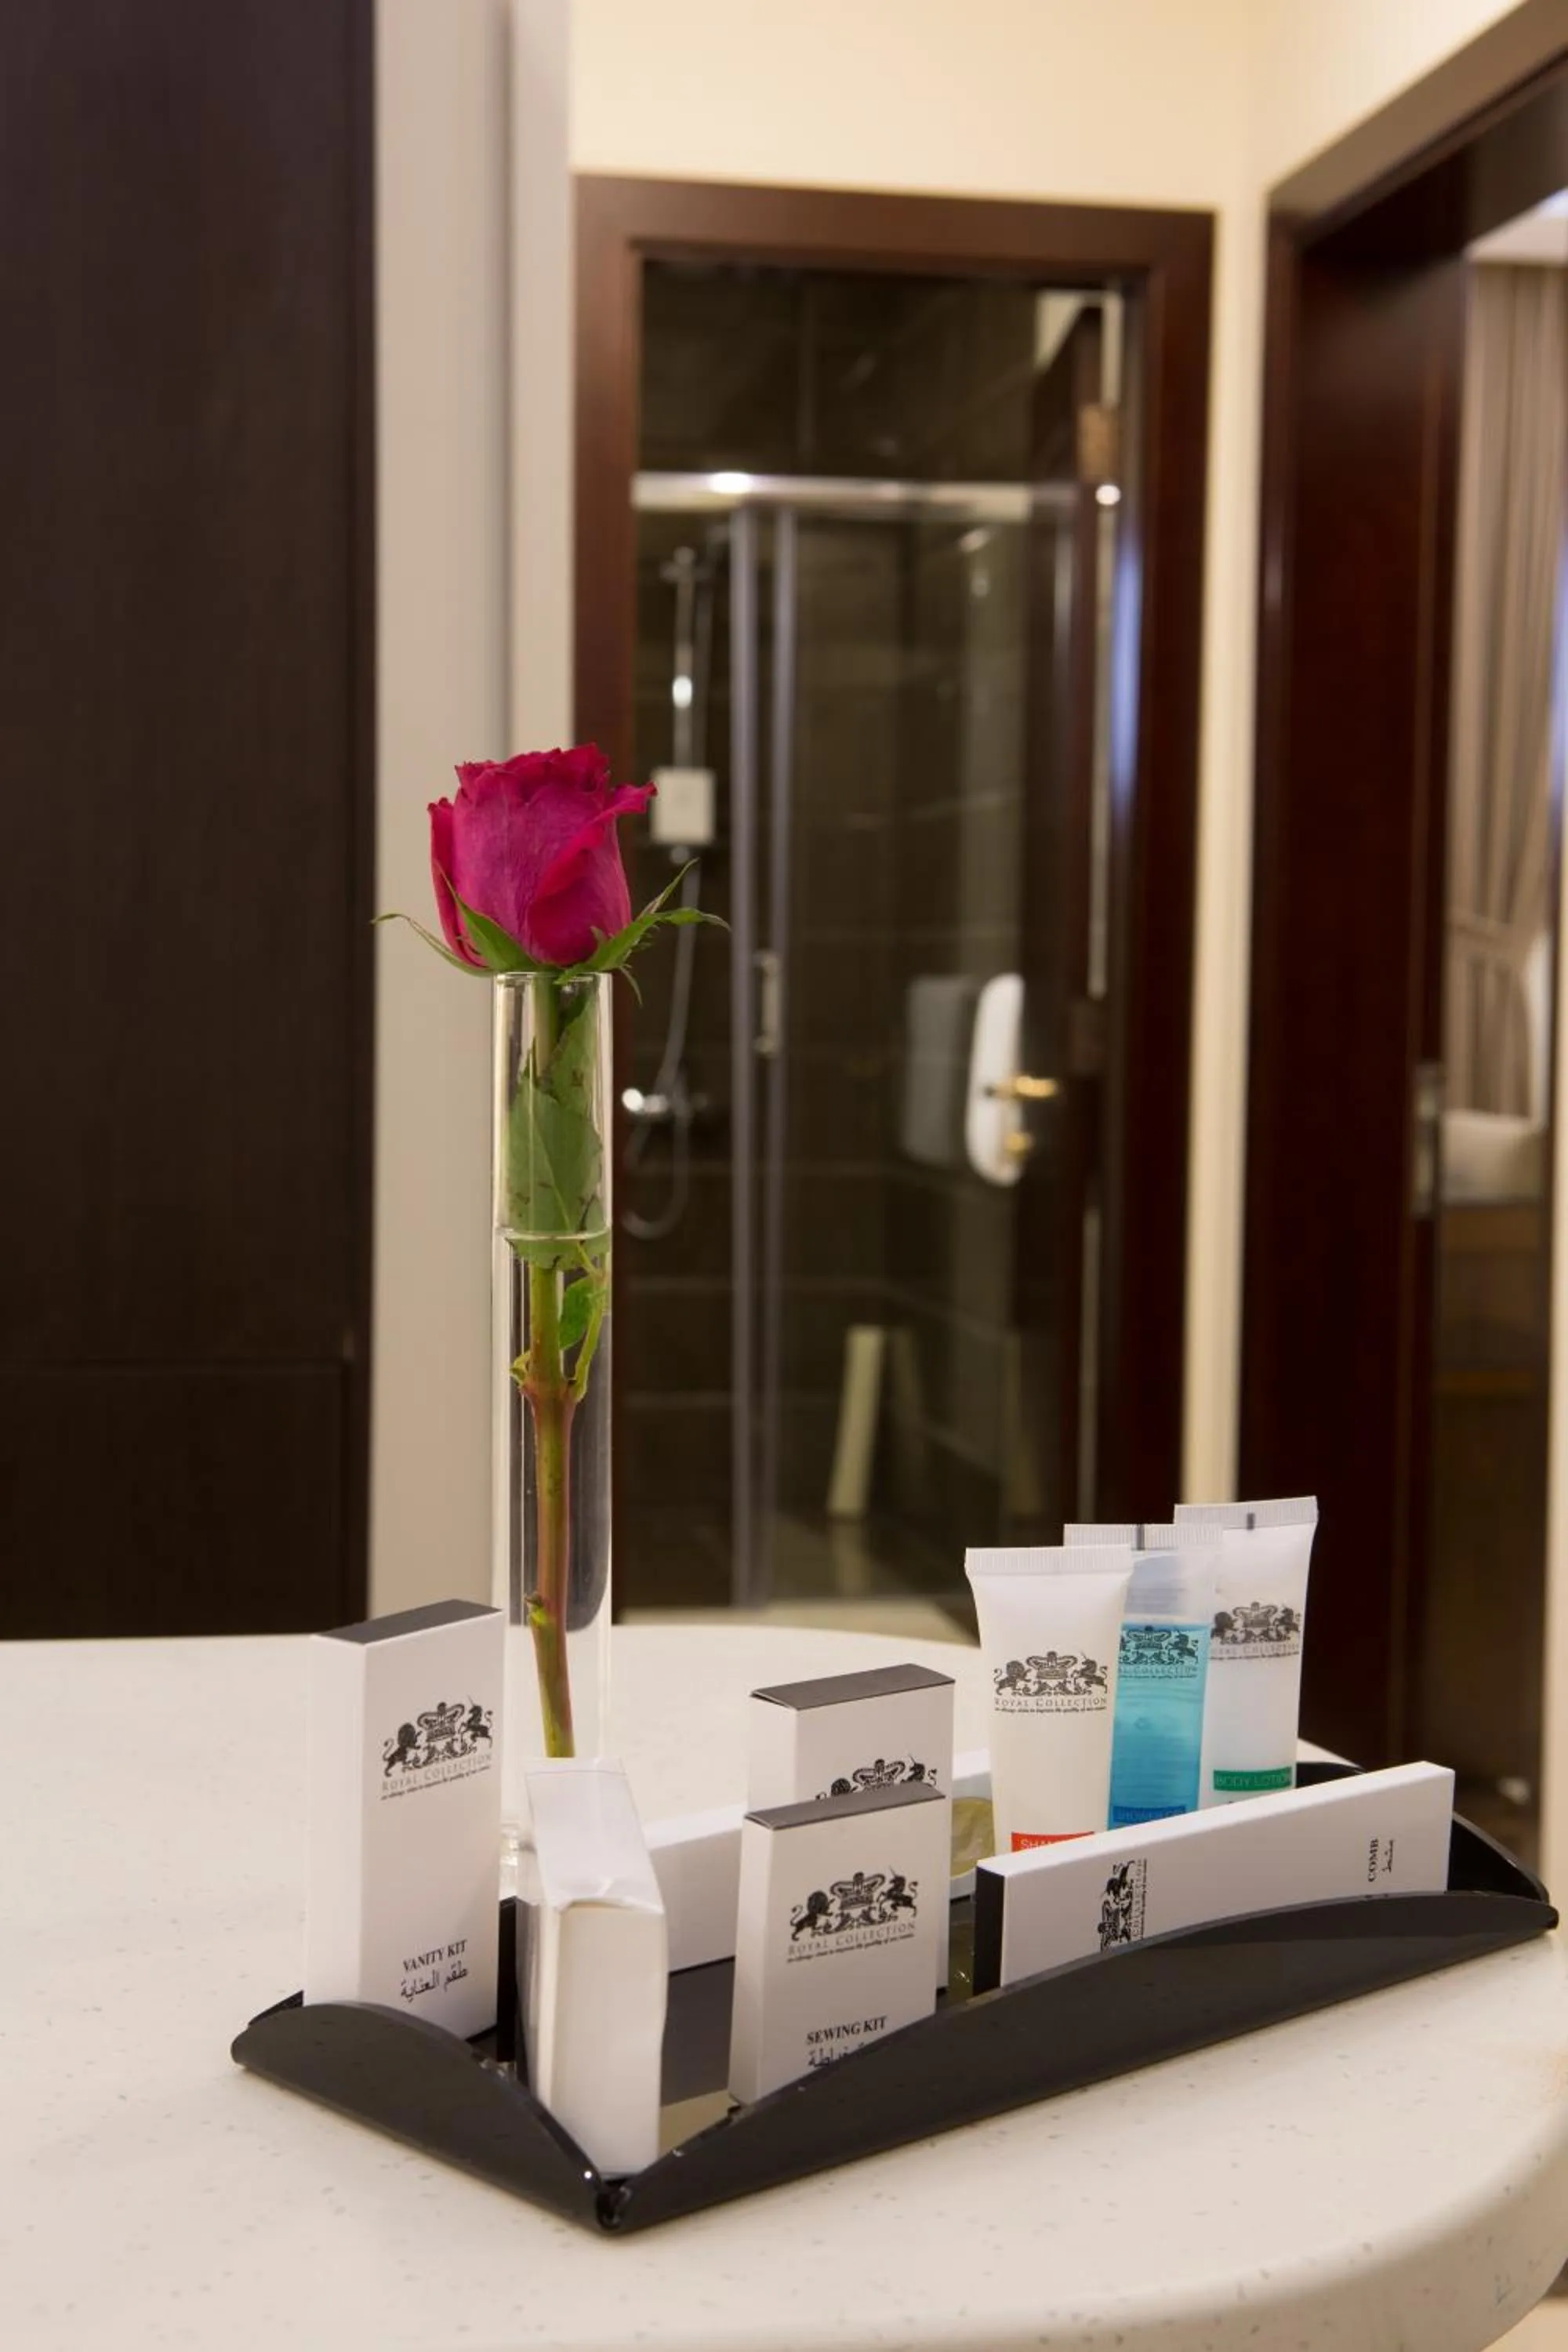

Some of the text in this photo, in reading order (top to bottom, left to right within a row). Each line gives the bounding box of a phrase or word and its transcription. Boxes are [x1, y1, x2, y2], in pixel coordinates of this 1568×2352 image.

[993, 1697, 1107, 1708] ROYAL COLLECTION
[381, 1774, 417, 1791] ROYAL
[423, 1753, 492, 1780] COLLECTION
[1216, 1776, 1250, 1788] BODY
[1367, 1838, 1378, 1882] COMB
[402, 1938, 468, 1972] VANITY KIT
[787, 1942, 829, 1956] ROYAL
[835, 1920, 916, 1947] COLLECTION
[400, 1960, 468, 2004] طقم العناية
[806, 2015, 887, 2045] SEWING KIT
